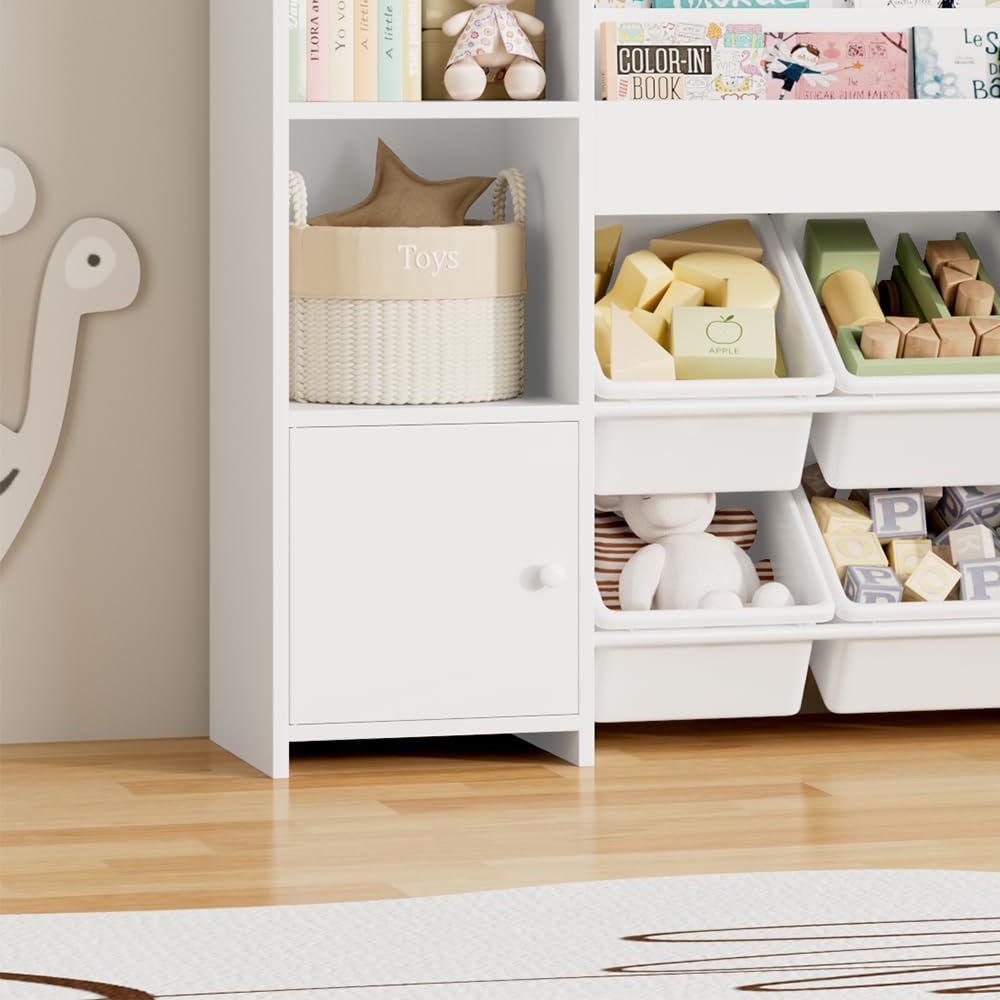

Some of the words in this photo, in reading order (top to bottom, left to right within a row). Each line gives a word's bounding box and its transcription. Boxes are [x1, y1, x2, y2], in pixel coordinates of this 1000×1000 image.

[384, 6, 393, 41] little
[309, 16, 319, 61] FLORA
[335, 29, 346, 51] Yo
[360, 39, 369, 50] A
[964, 28, 983, 47] Le
[385, 48, 393, 59] A
[633, 76, 681, 100] BOOK
[398, 244, 460, 278] Toys
[708, 347, 738, 355] APPLE
[877, 498, 918, 531] P
